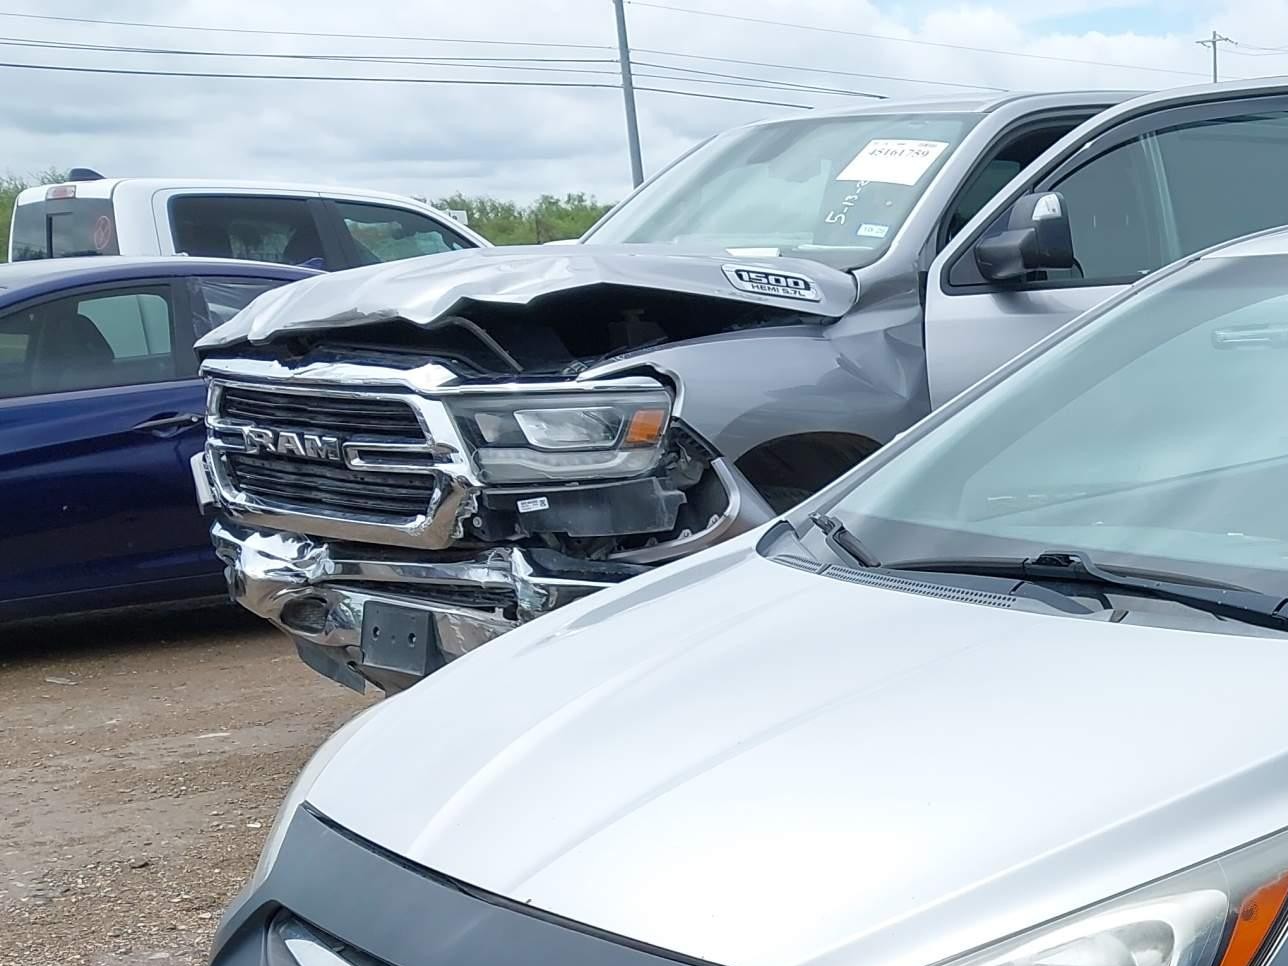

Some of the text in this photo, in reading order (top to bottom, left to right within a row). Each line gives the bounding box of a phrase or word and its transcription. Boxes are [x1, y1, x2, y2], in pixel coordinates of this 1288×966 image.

[737, 270, 806, 290] 1500
[751, 283, 806, 297] HEMI 5.7L
[242, 427, 341, 461] RAM
